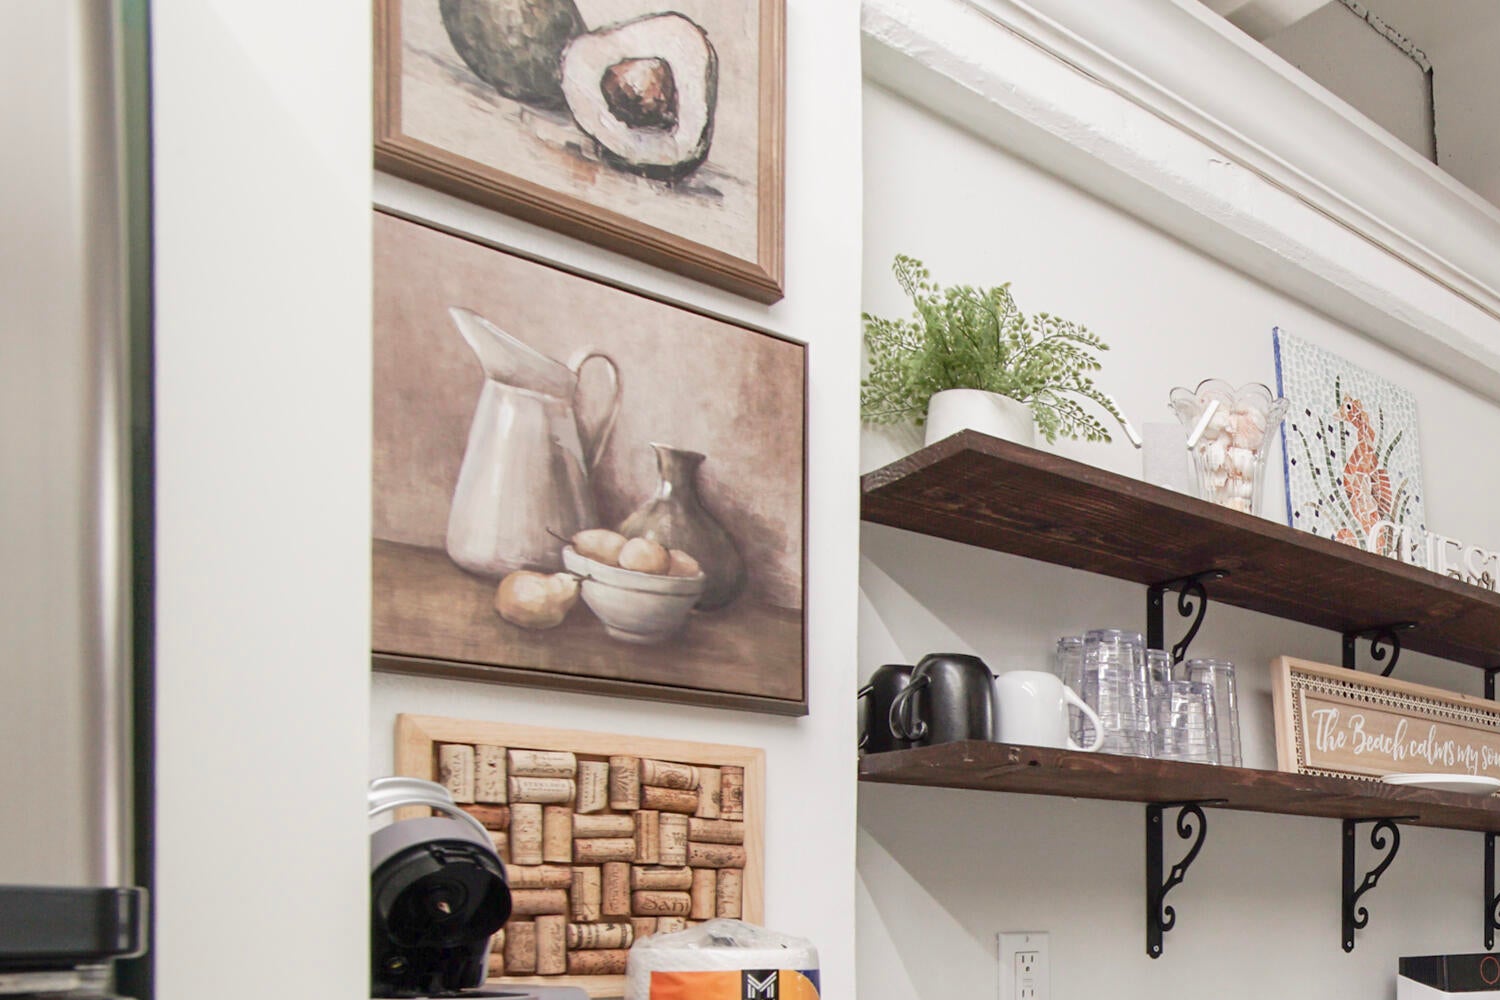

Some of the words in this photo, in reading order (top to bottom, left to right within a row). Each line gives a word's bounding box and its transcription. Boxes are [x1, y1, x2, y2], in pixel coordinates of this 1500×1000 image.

[1312, 708, 1347, 752] The
[1348, 713, 1409, 761] Beach
[1410, 724, 1455, 766] calms
[1457, 743, 1479, 775] my
